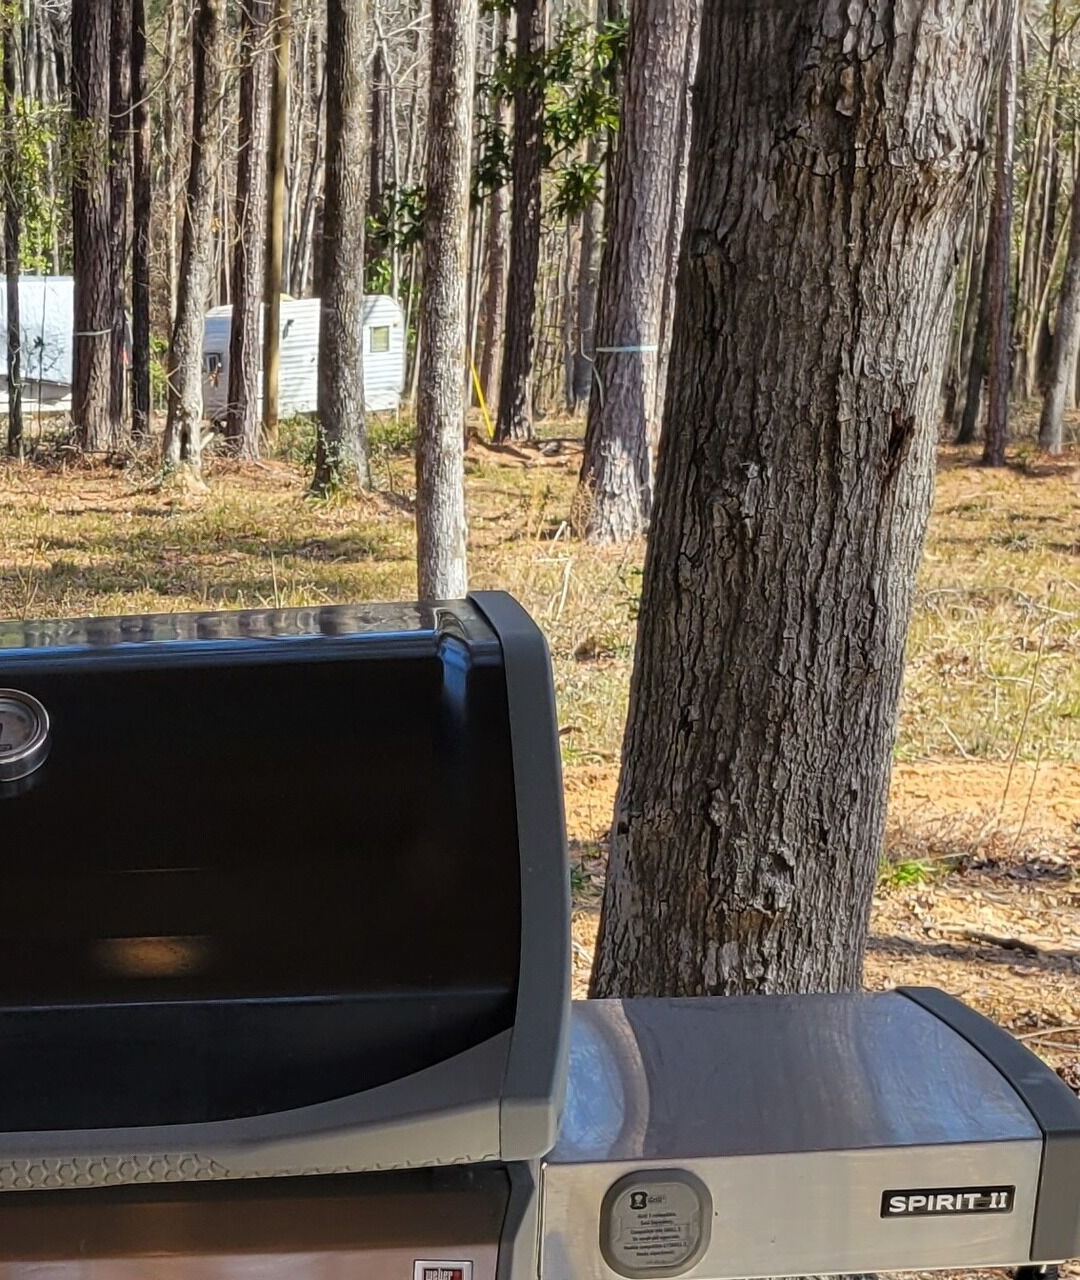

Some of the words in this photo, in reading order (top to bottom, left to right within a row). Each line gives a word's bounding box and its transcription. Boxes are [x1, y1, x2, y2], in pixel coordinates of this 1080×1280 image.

[889, 1193, 981, 1213] SPIRIT
[989, 1192, 1007, 1209] II
[425, 1268, 453, 1280] weber
